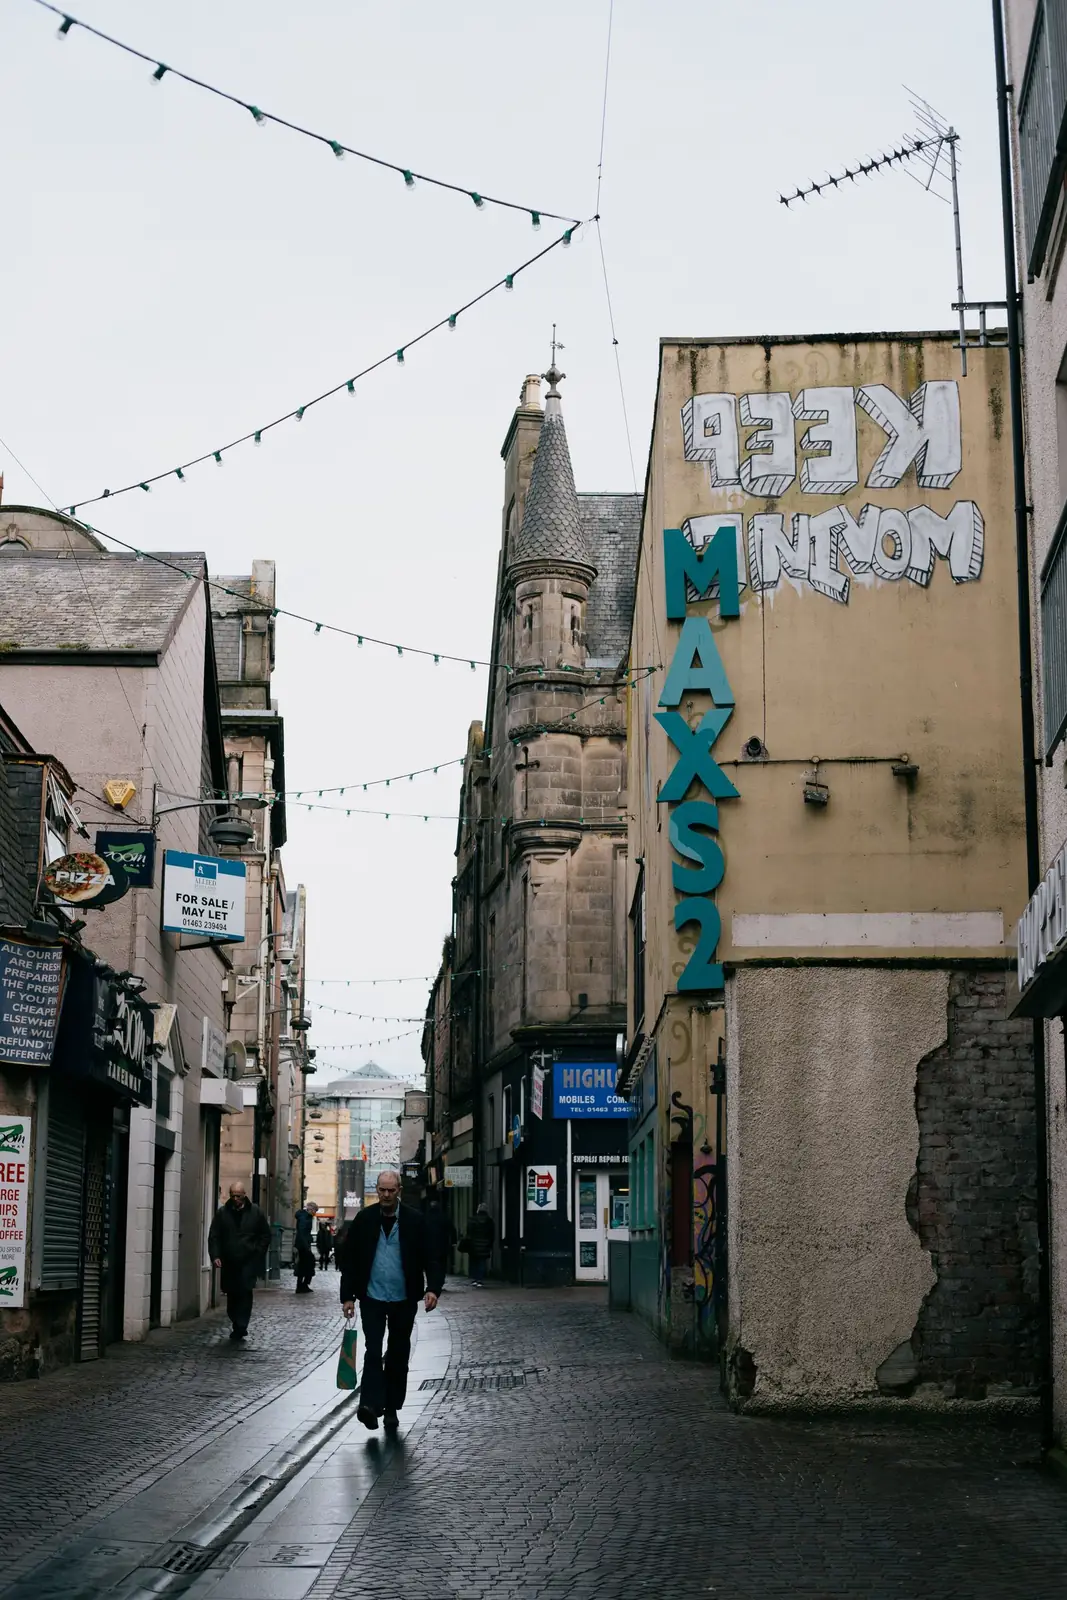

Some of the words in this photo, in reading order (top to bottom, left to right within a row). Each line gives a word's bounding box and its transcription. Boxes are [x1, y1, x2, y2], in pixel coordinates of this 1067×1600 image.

[55, 871, 116, 886] PIZZA
[175, 893, 198, 905] FOR
[201, 897, 228, 909] SALE
[182, 906, 205, 918] MAY
[208, 910, 229, 921] LET
[183, 918, 203, 928] 01463
[204, 921, 227, 931] 239494
[1, 944, 23, 956] ALL
[26, 950, 51, 960] OUR
[9, 957, 33, 970] ARE
[4, 967, 58, 982] PREPARED
[2, 978, 24, 989] THE
[6, 990, 16, 999] IF
[19, 992, 45, 1004] YOU
[12, 1026, 28, 1036] WE
[31, 1028, 54, 1039] WILL
[0, 1036, 44, 1049] REFUND
[559, 1095, 595, 1104] MOBILES
[573, 1155, 598, 1163] EXPRESS
[598, 1155, 620, 1163] REPAIR
[0, 1188, 20, 1201] RGE
[2, 1218, 17, 1228] TEA
